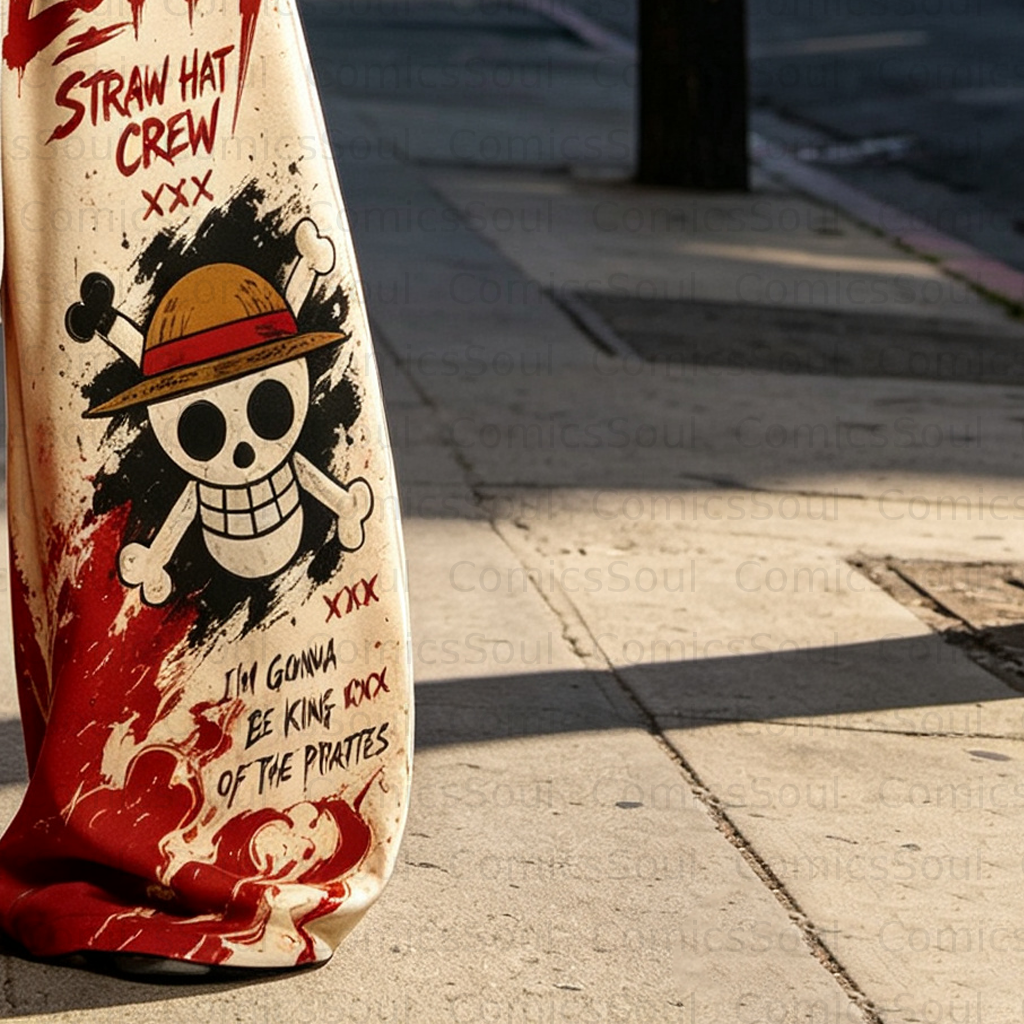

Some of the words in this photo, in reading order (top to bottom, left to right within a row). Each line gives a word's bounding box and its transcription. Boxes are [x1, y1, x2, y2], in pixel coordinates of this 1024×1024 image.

[45, 55, 170, 145] STRAW
[178, 44, 235, 103] HAT
[116, 97, 221, 177] CREW
[217, 761, 251, 809] OF
